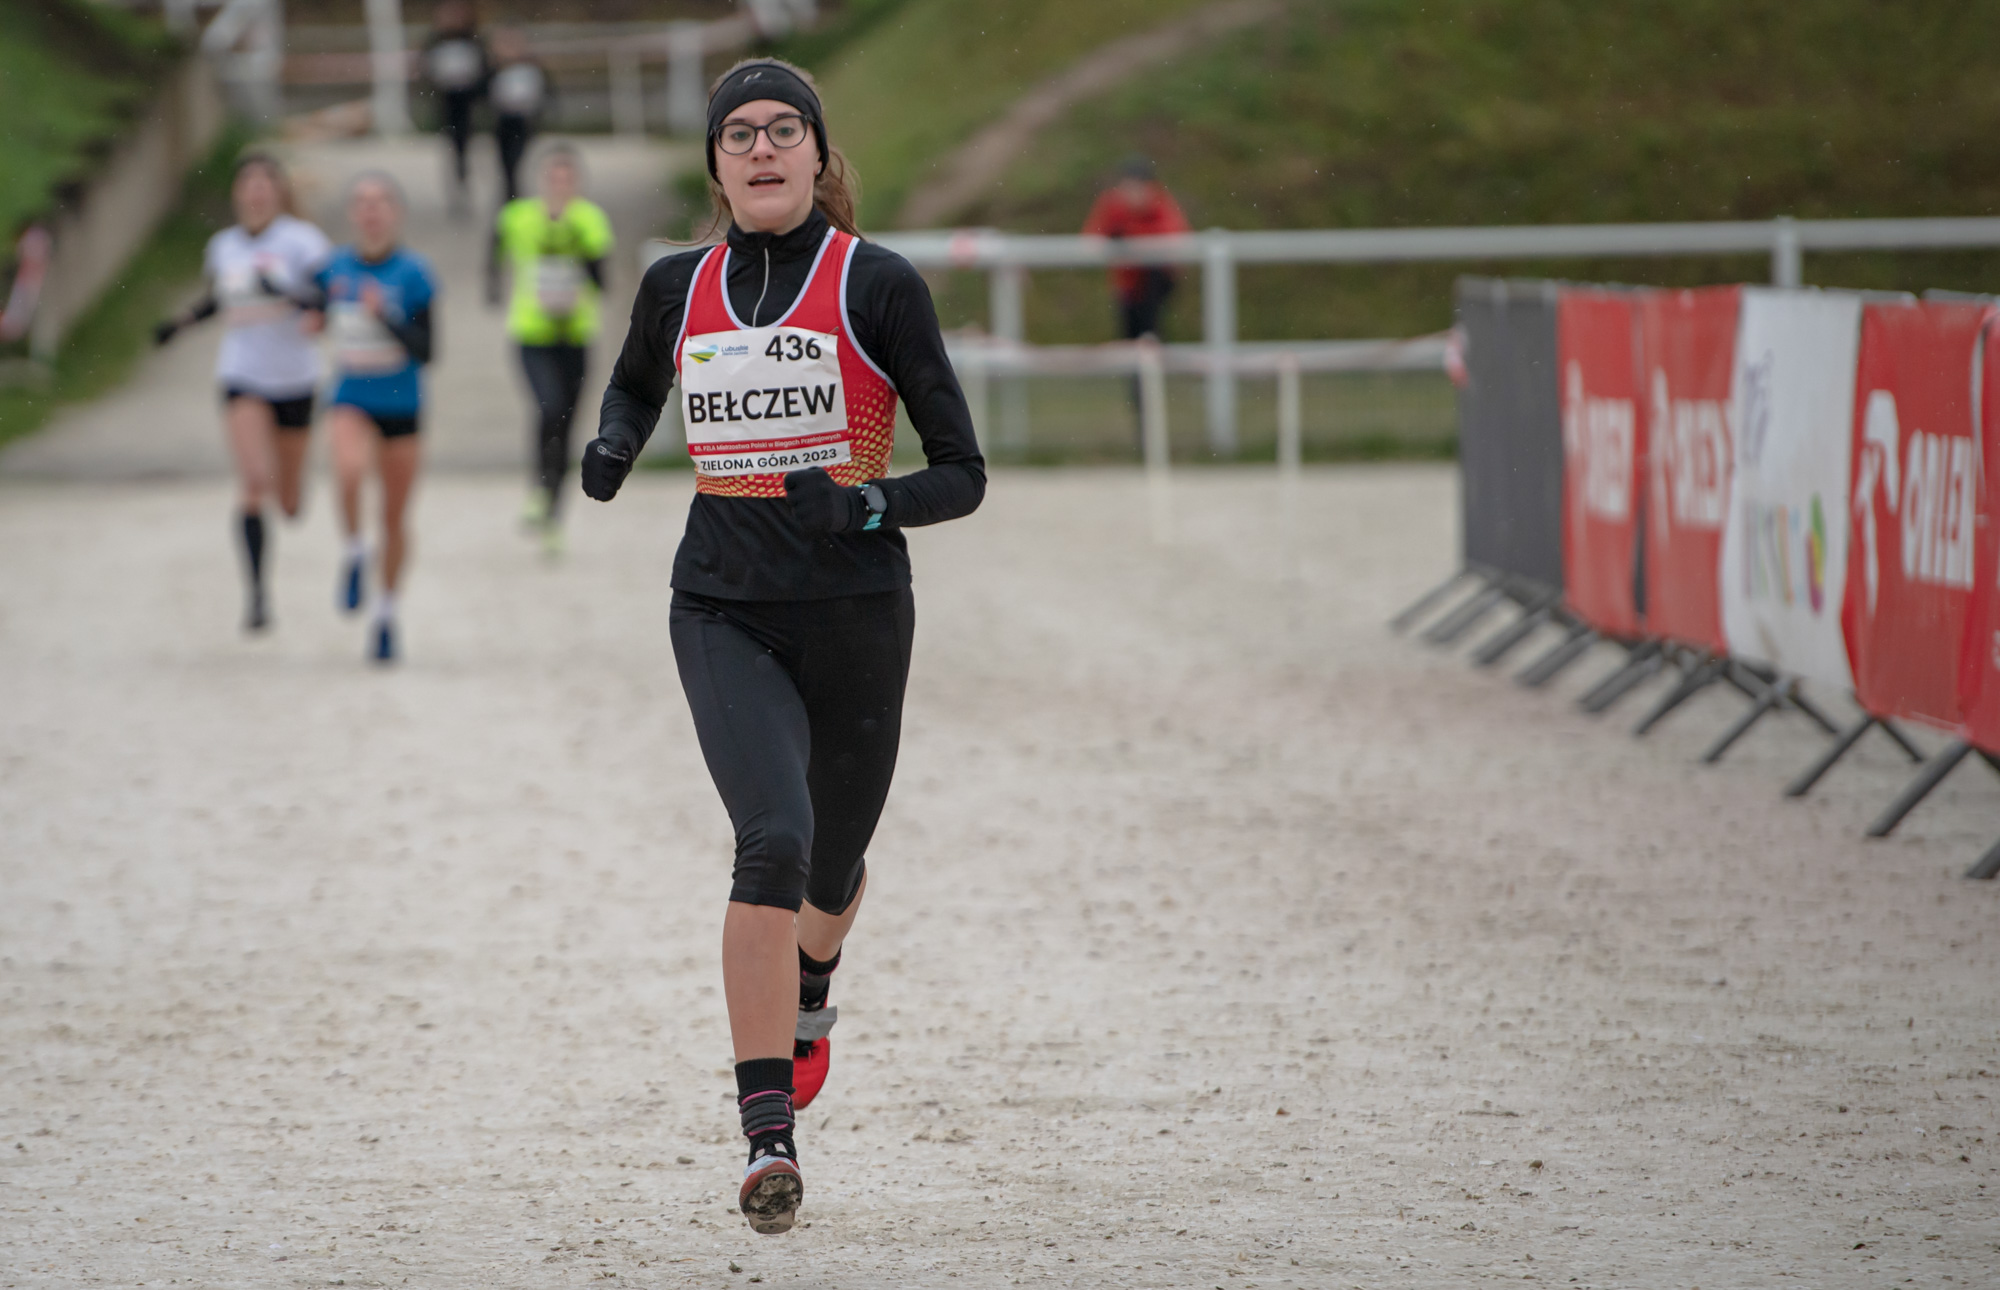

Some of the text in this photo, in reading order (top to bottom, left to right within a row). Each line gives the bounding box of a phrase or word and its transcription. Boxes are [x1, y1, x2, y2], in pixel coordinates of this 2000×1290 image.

[764, 333, 822, 362] 436
[688, 383, 836, 423] BEŁCZEW
[717, 443, 749, 451] Mistrzostwa
[751, 441, 767, 449] Polski
[774, 439, 800, 448] Biegach
[800, 433, 841, 444] Przełajowych
[700, 448, 837, 471] ZIELONA GÓRA 2023
